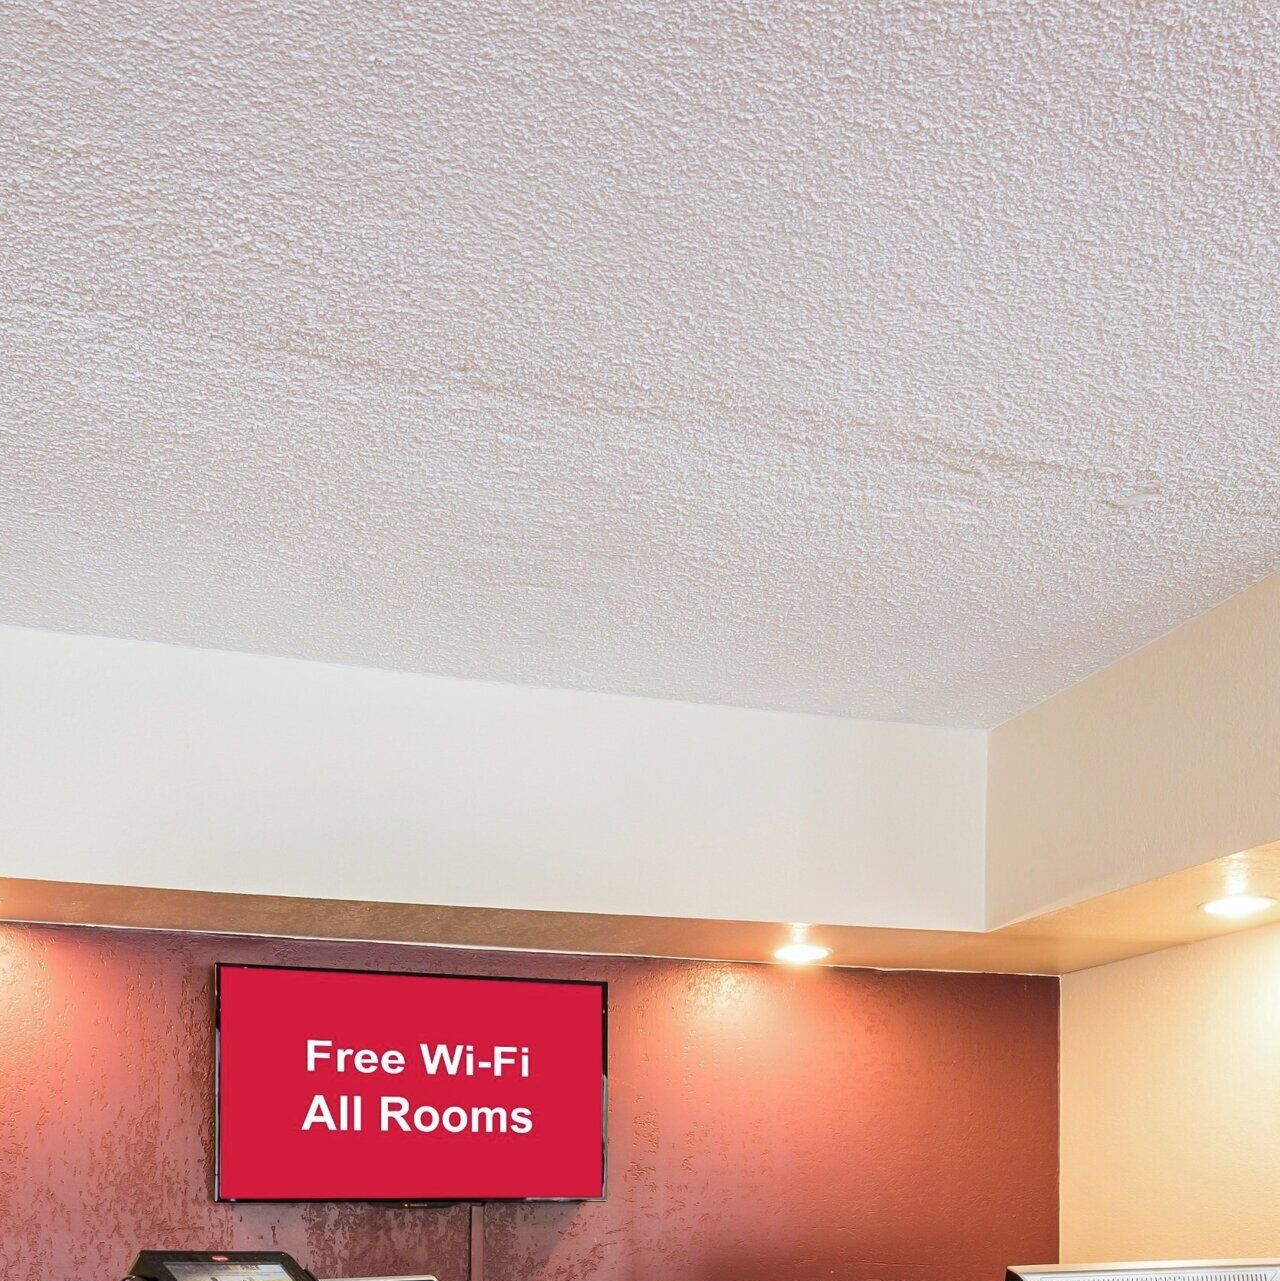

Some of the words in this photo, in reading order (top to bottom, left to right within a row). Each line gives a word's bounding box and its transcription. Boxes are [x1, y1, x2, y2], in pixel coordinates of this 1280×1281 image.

[306, 1039, 406, 1075] Free
[419, 1043, 529, 1078] Wi-Fi
[301, 1094, 362, 1132] All
[380, 1095, 533, 1134] Rooms
